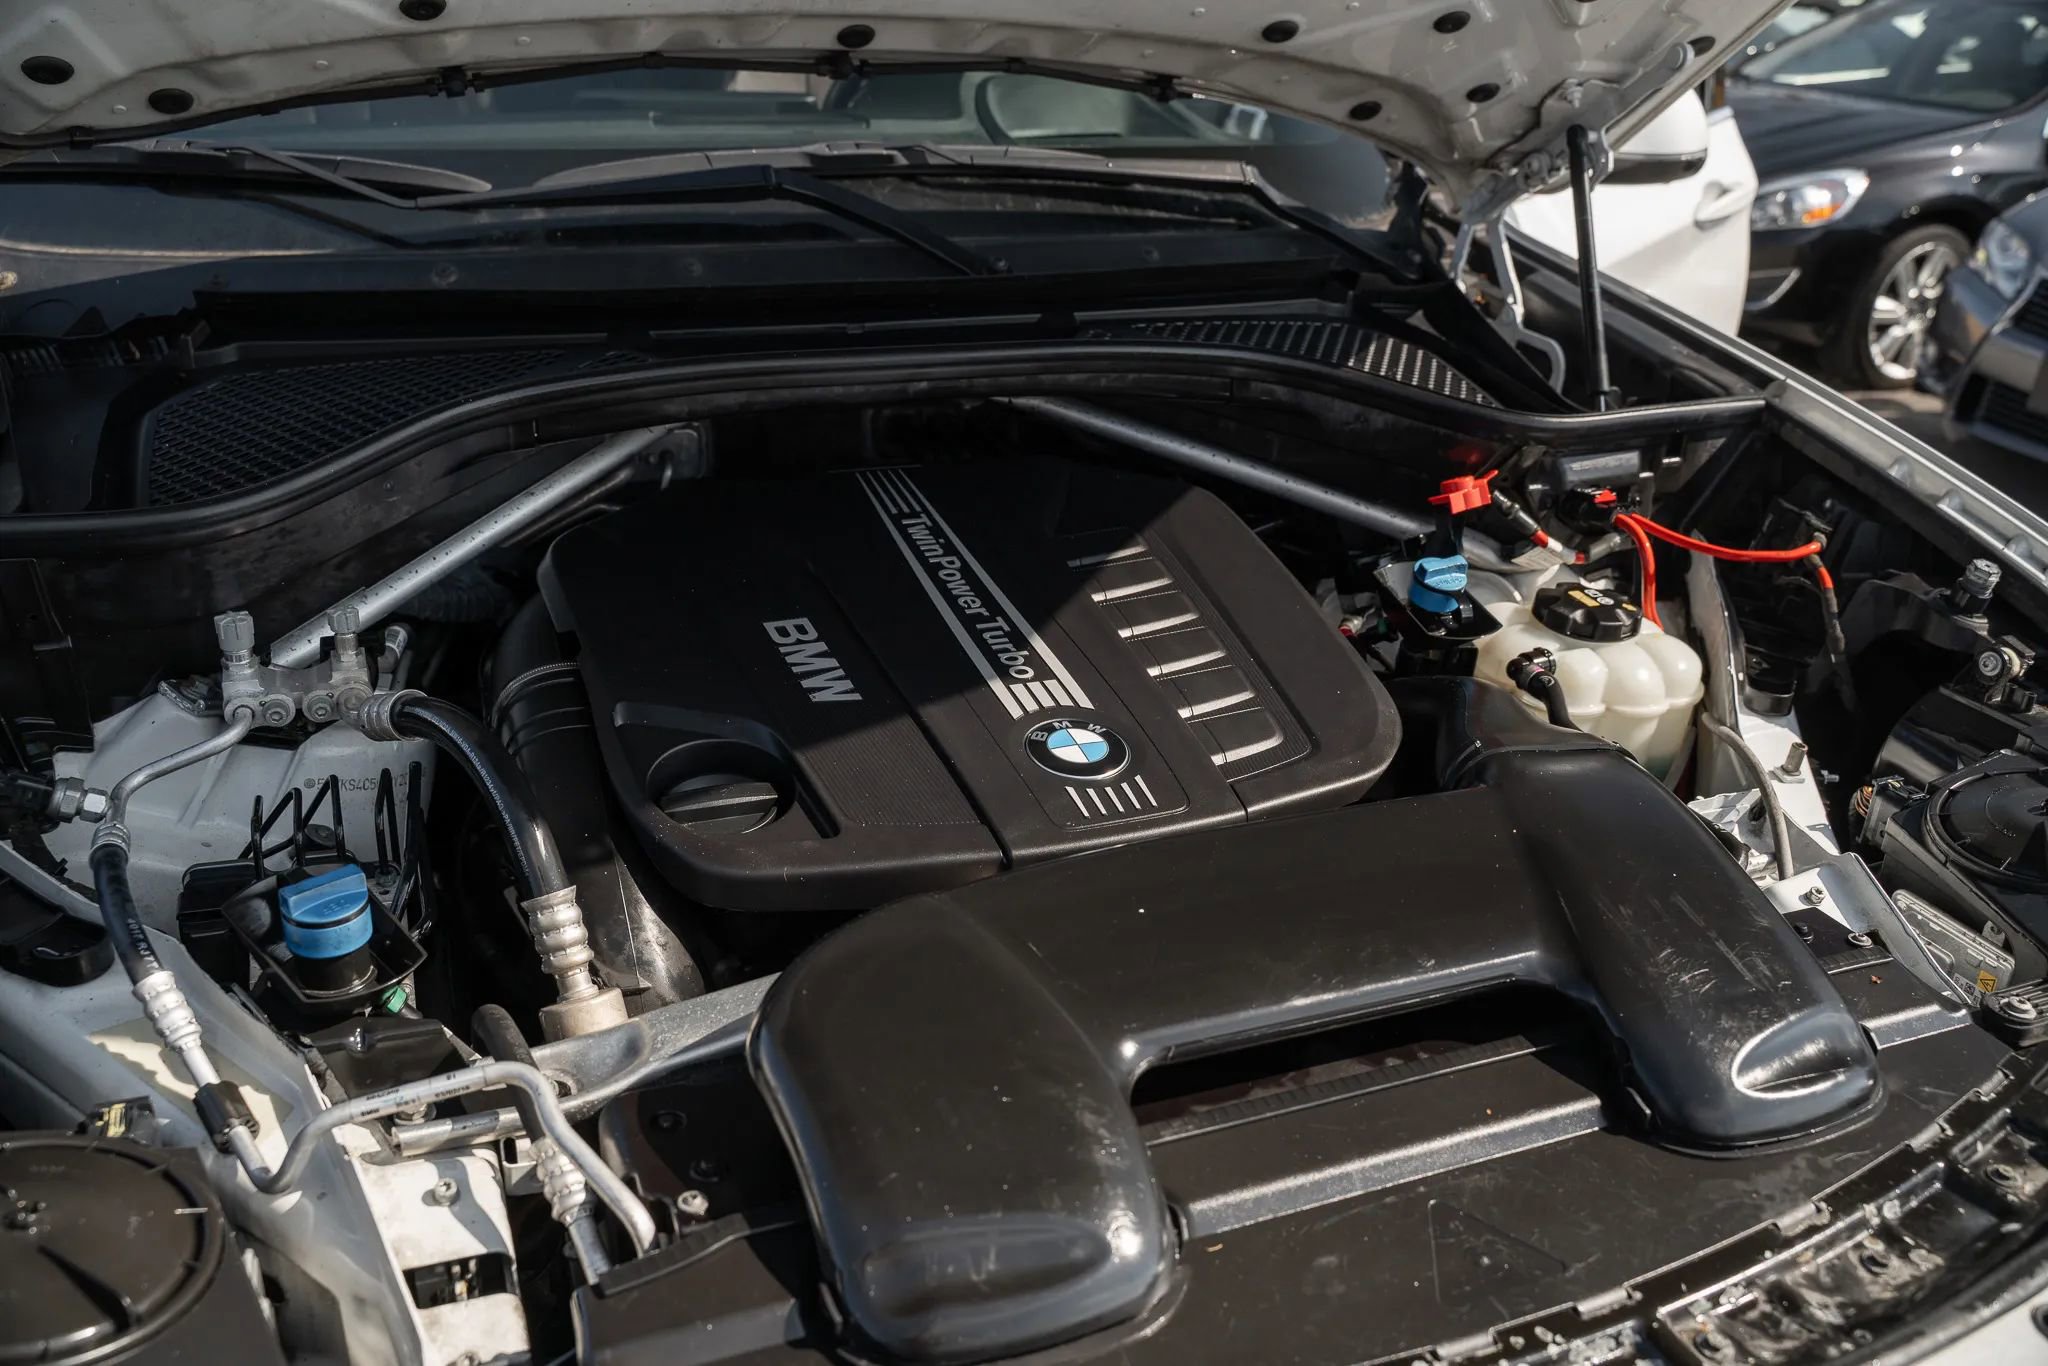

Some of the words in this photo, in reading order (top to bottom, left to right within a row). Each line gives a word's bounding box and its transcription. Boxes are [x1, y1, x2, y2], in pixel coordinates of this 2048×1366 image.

[901, 513, 990, 616] TwinPower
[975, 616, 1035, 679] Turbo
[762, 617, 863, 702] BMW
[1030, 720, 1107, 742] BMW
